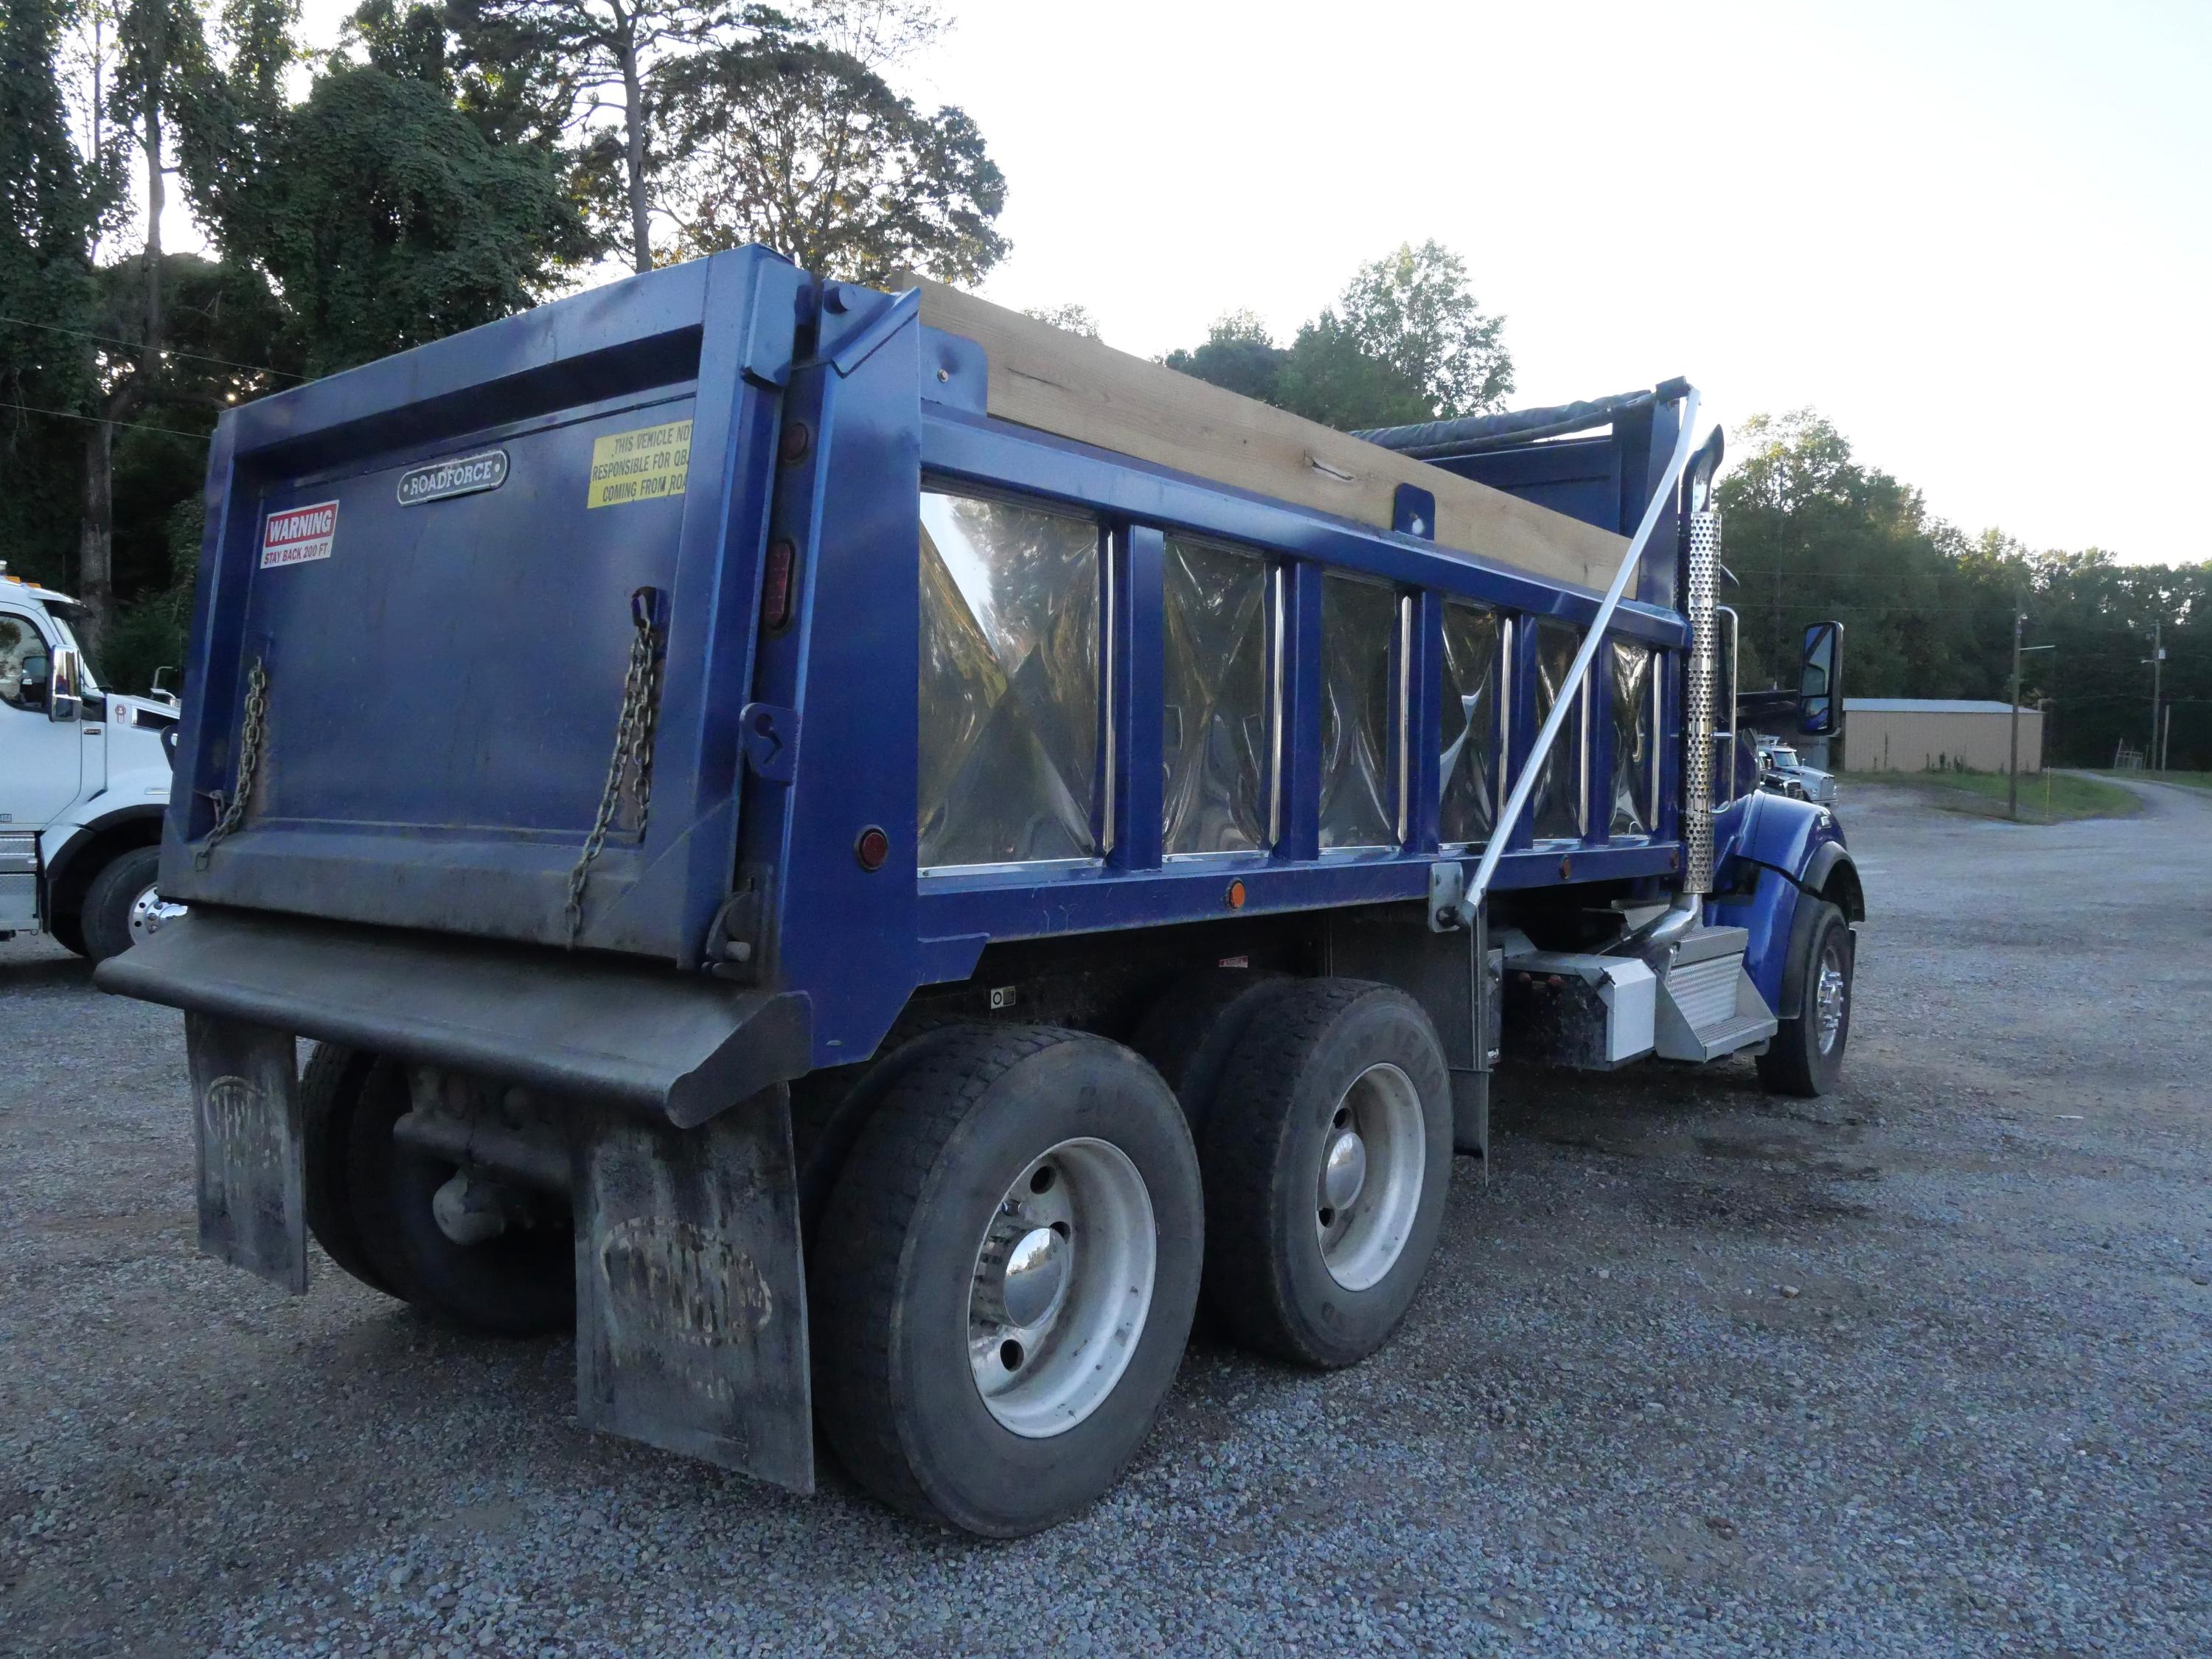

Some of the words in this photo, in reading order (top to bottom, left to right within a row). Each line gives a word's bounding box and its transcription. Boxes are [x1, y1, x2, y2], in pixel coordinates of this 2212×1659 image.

[615, 436, 633, 454] THIS
[637, 428, 674, 450] VEHICLE
[676, 425, 693, 442] NO
[410, 460, 493, 495] ROADFORCE
[592, 456, 650, 481] RESPONSIBLE
[653, 451, 670, 470] FOR
[602, 481, 637, 502] COMING
[640, 476, 667, 495] FROM
[270, 509, 333, 543] WARNING
[264, 551, 283, 565] STAY
[282, 547, 302, 562] BACK
[303, 544, 318, 558] 200
[319, 542, 329, 555] FT
